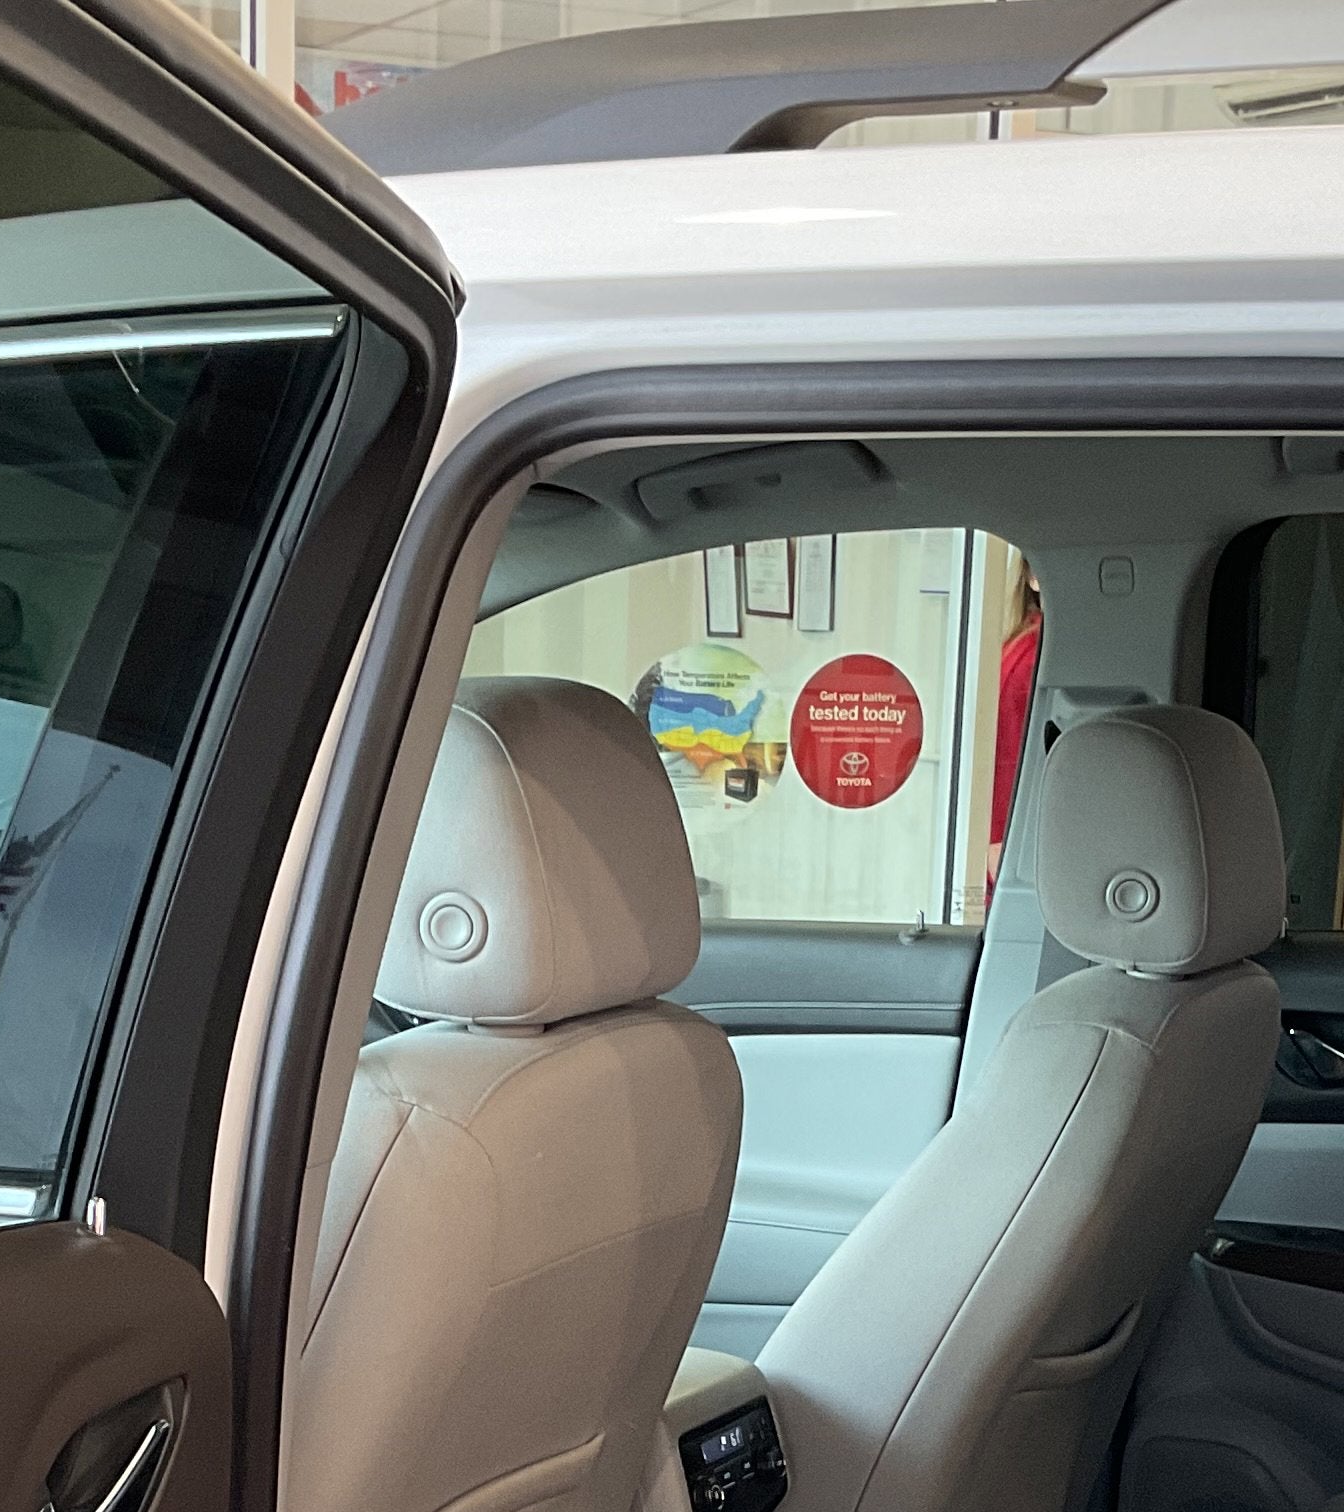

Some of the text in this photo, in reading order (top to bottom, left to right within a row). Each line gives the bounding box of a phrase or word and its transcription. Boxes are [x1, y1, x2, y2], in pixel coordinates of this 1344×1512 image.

[819, 690, 897, 704] Get your battery
[809, 705, 907, 725] tested today
[836, 777, 872, 787] TOYOTA
